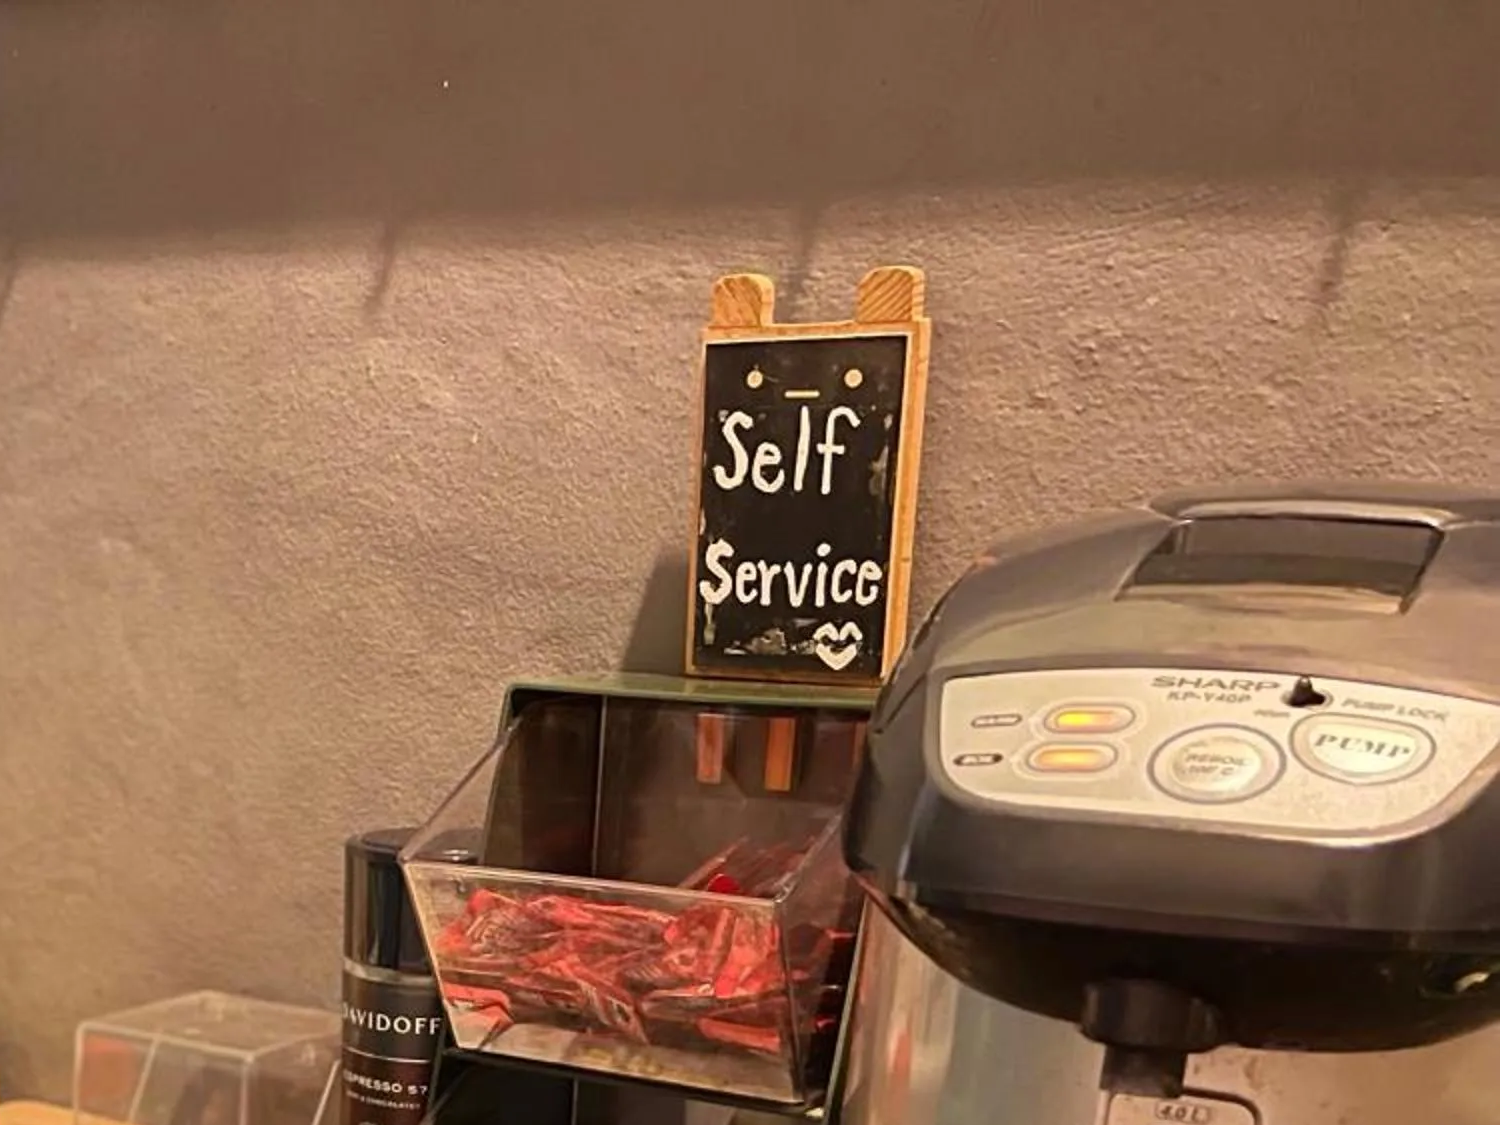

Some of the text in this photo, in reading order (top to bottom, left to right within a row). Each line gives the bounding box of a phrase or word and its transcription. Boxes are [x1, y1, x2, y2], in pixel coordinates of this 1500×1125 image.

[712, 405, 861, 494] Self
[699, 538, 883, 607] Service
[1151, 675, 1281, 692] SHARP
[1397, 705, 1449, 722] LOCK
[1315, 734, 1411, 757] PUMP
[343, 1069, 403, 1093] SPRESSO
